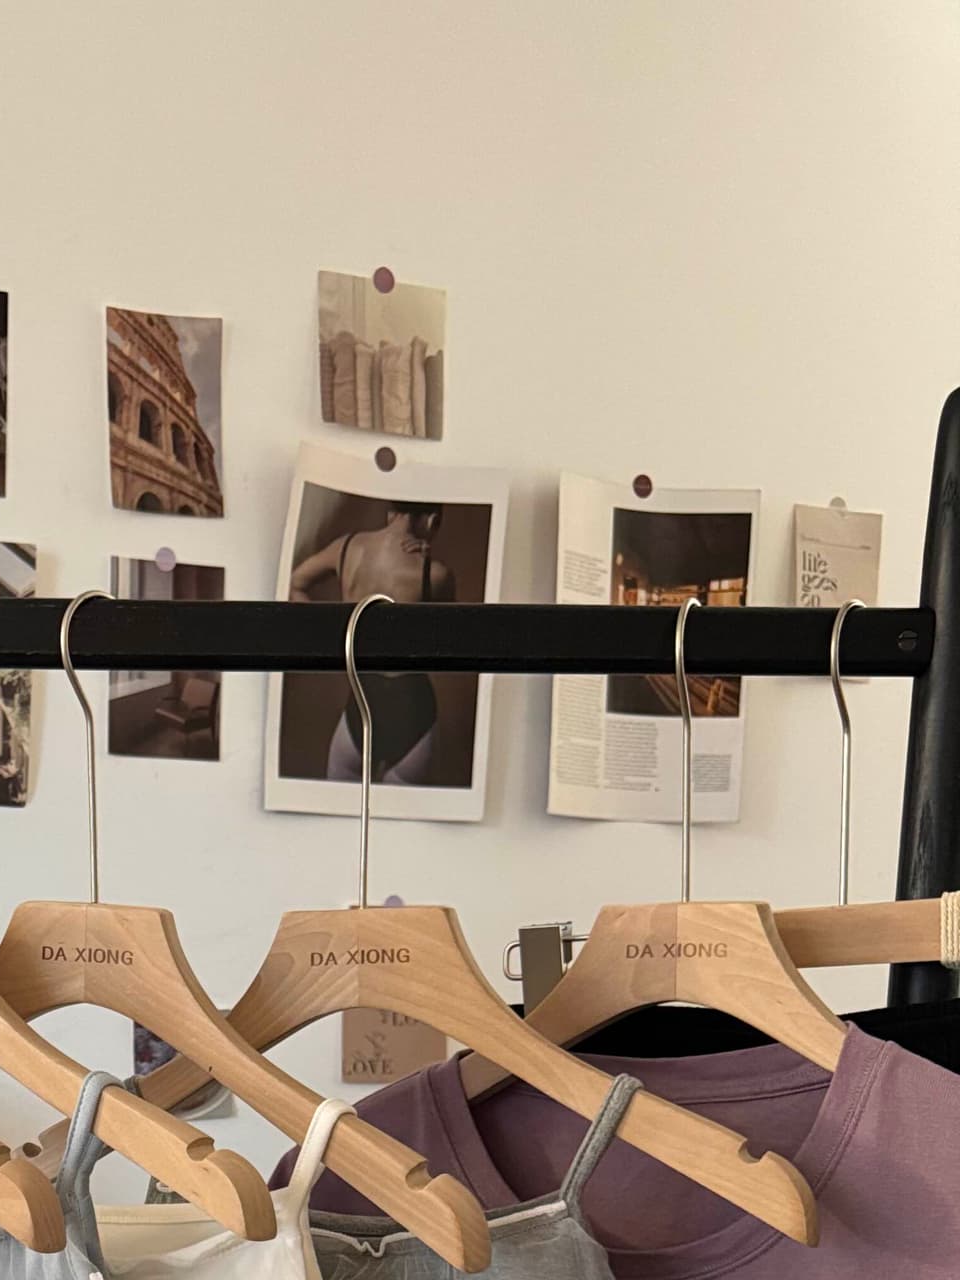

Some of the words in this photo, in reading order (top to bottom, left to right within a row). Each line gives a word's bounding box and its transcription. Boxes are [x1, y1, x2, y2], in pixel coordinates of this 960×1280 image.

[41, 945, 67, 962] DA
[74, 947, 135, 966] XIONG
[309, 951, 339, 967] DA
[345, 947, 411, 966] XIONG
[625, 943, 655, 960] DA
[662, 942, 729, 960] XIONG
